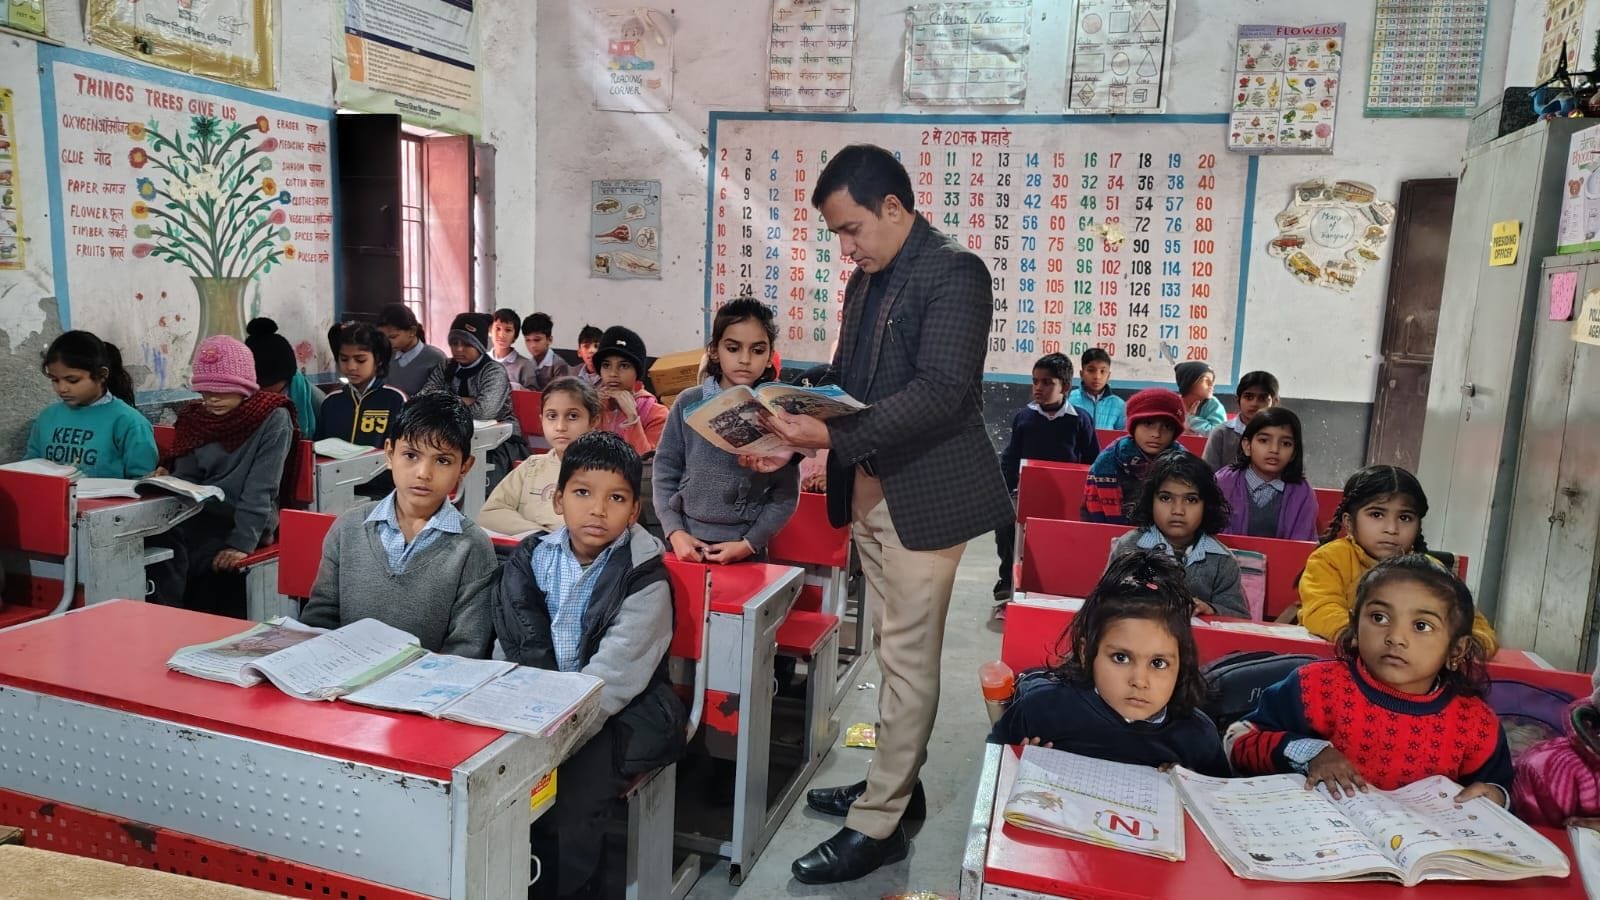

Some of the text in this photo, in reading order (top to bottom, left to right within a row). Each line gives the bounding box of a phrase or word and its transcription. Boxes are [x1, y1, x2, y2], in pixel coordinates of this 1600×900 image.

[1276, 26, 1338, 35] FLOWERS
[73, 73, 236, 121] THINGS TREES GIVE US
[609, 86, 641, 95] CORNER
[62, 113, 98, 131] OXYGEN
[921, 131, 930, 145] 2
[932, 127, 942, 145] से
[61, 148, 84, 165] GLUE
[720, 148, 1215, 169] 2 3 4 5 10 11 12 13 14 15 16 17 18 19 20
[67, 179, 98, 194] PAPER
[795, 170, 1214, 190] 10 20 22 24 26 28 30 32 34 36 38 40
[768, 188, 1212, 212] 12 15 33 36 39 42 45 48 51 54 57 60
[70, 205, 108, 219] FLOWER
[742, 207, 1212, 232] 12 16 20 48 52 56 60 72 76 80
[72, 225, 104, 237] TIMBER
[717, 224, 1214, 254] 10 15 25 60 65 70 75 90 95 100
[76, 244, 105, 257] FRUITS
[717, 244, 1212, 277] 12 24 30 36 78 84 90 96 102 108 114 120
[740, 264, 1209, 298] 21 28 35 42 91 98 105 112 119 126 133 140
[765, 285, 1180, 318] 32 40 112 120 128 136 144 152
[789, 306, 1207, 340] 45 126 135 144 153 162 171 180
[1016, 339, 1208, 360] 140 180 200
[52, 427, 94, 445] KEEP
[45, 445, 98, 465] GOING
